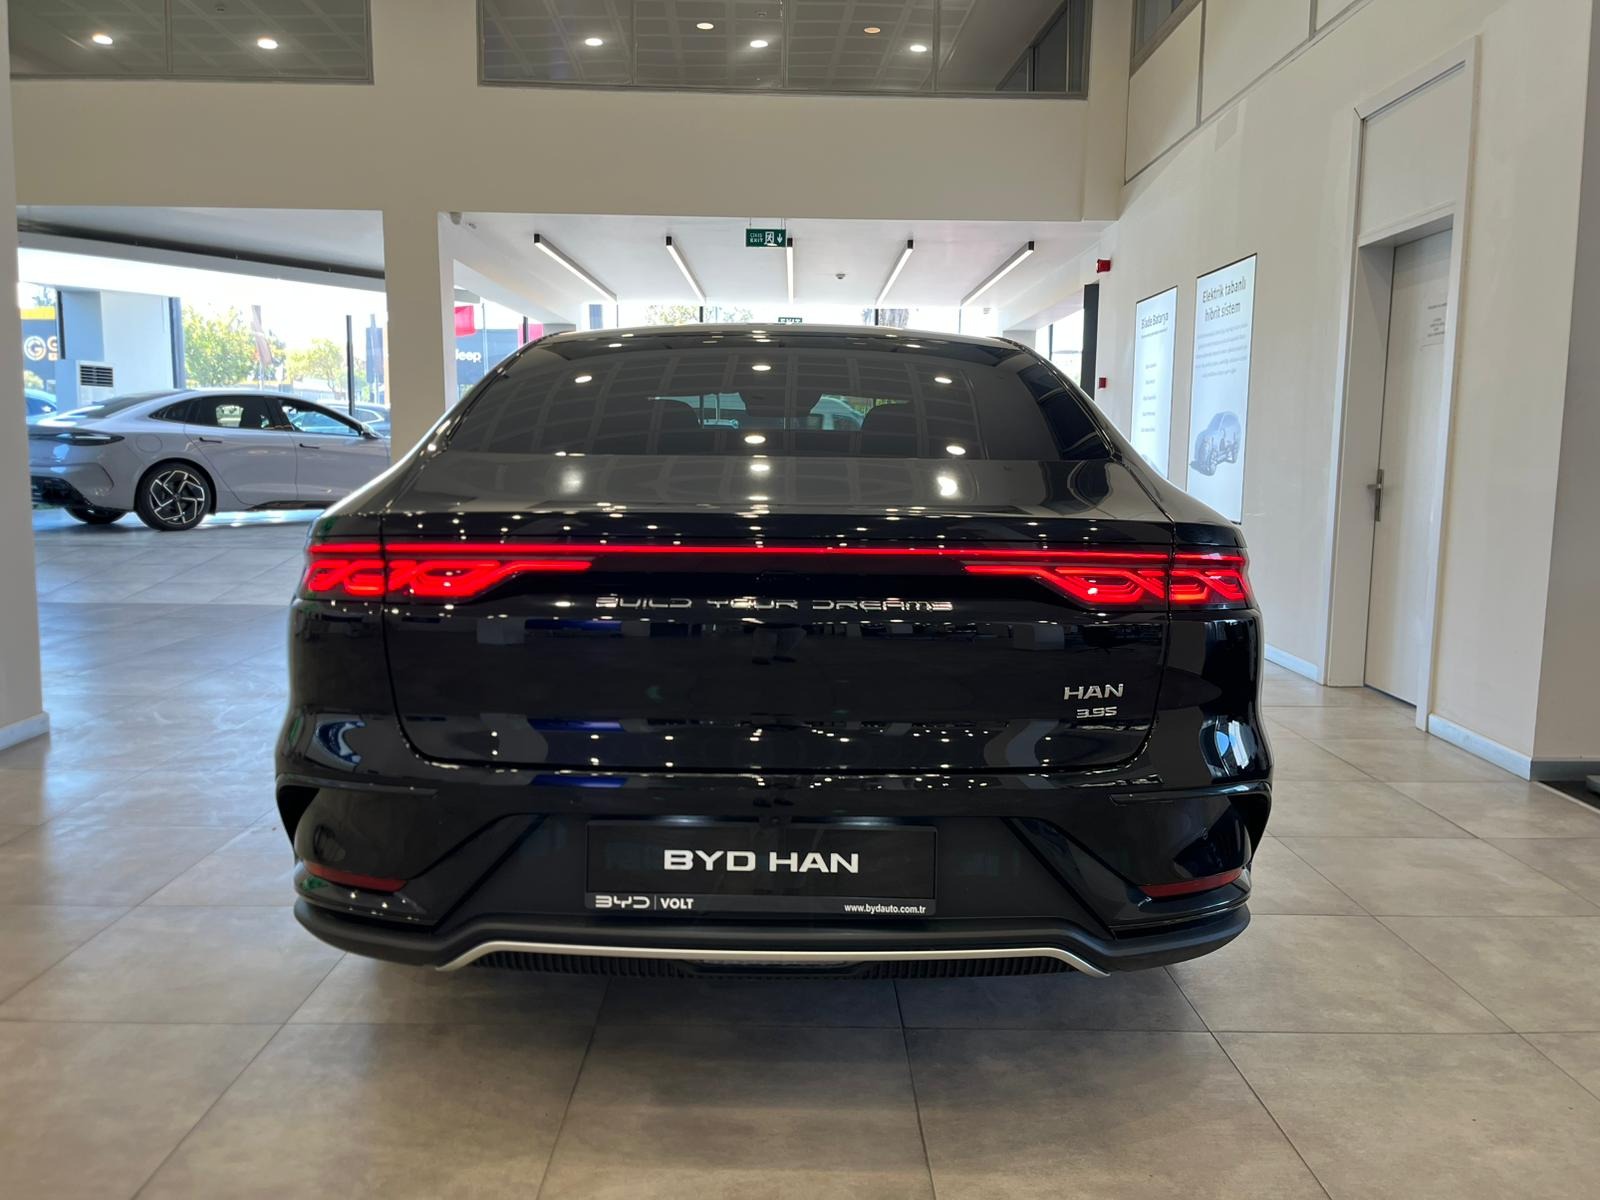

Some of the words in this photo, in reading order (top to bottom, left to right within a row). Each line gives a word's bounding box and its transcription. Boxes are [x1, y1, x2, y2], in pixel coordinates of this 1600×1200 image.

[1221, 302, 1241, 318] sistem
[596, 596, 693, 608] BUILD
[706, 596, 799, 609] YOUR
[812, 598, 953, 611] DREAMS
[1063, 683, 1124, 700] HAN
[1076, 706, 1118, 719] 3.9S
[664, 849, 756, 872] BYD
[769, 851, 859, 873] HAN
[595, 895, 650, 909] BYD
[660, 897, 694, 909] VOLT
[844, 903, 926, 914] www.bydauto.com.tr
